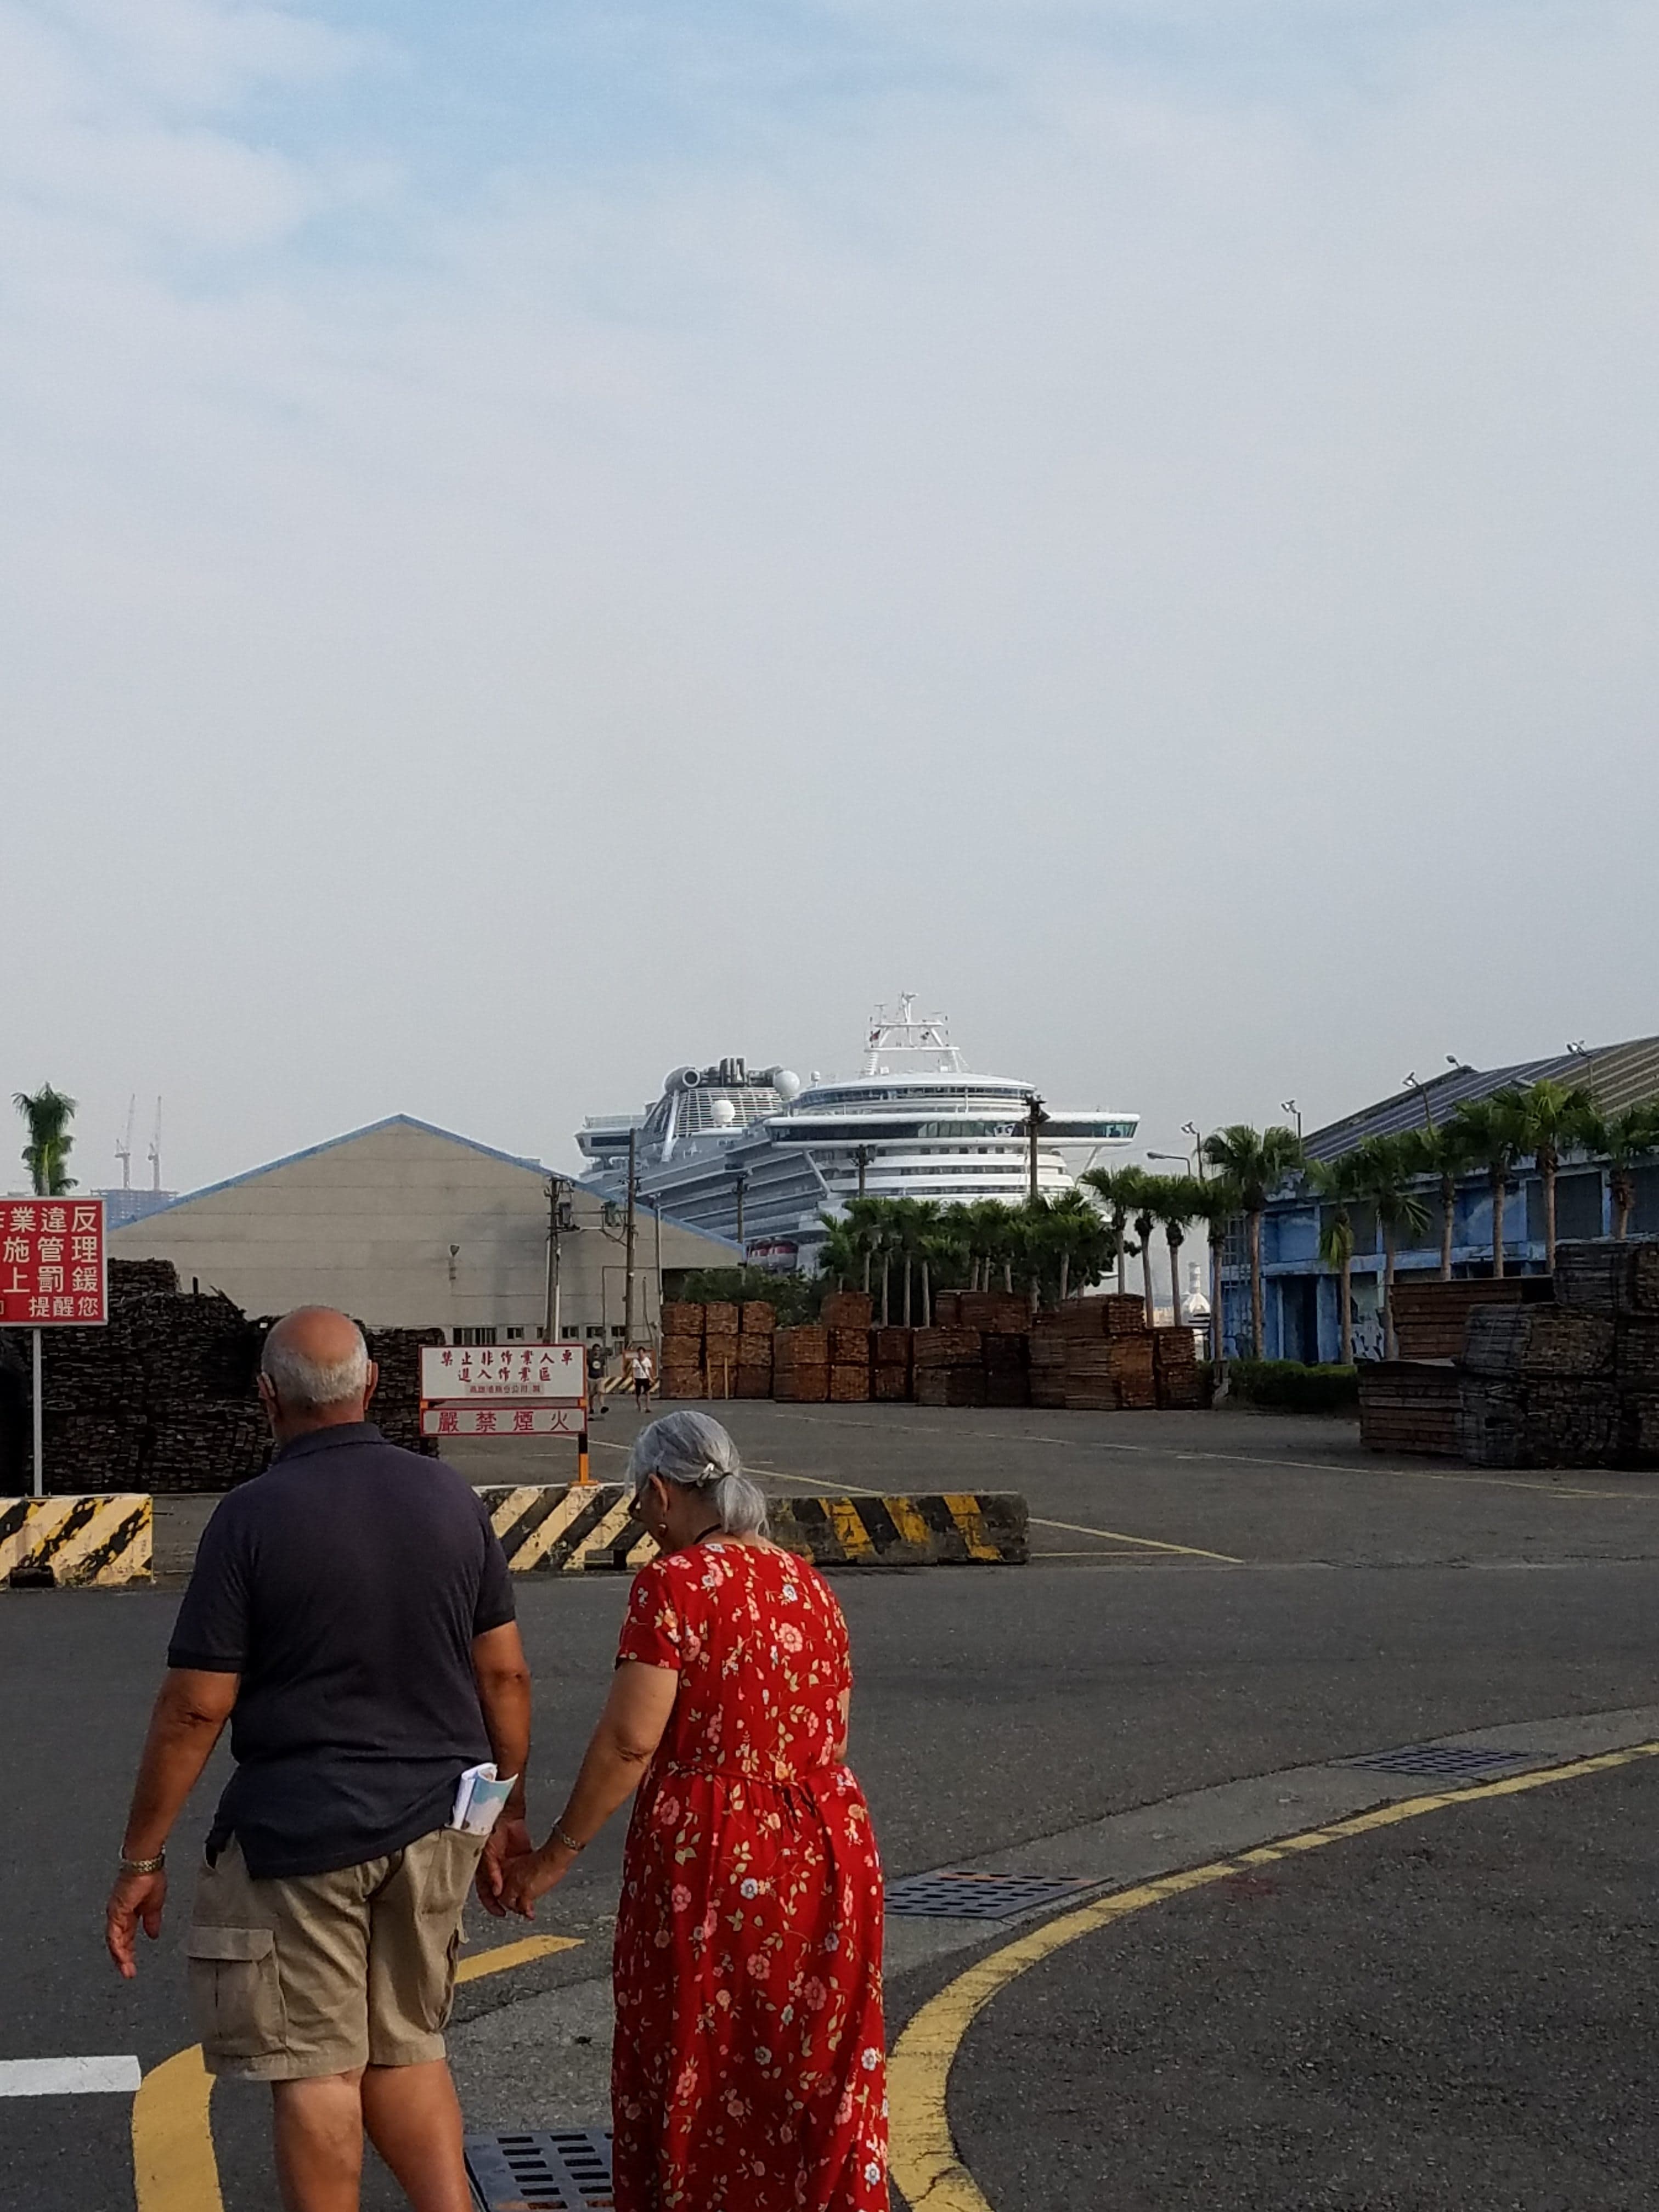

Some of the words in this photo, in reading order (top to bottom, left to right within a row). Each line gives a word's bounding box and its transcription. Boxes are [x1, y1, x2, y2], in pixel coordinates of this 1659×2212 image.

[3, 1236, 98, 1263] 施管理
[3, 1266, 98, 1293] 上罰鍰
[29, 1296, 99, 1317] 提醒您
[441, 1350, 573, 1366] 禁止非作業人車
[458, 1367, 552, 1382] 進入作業區
[437, 1410, 569, 1432] 嚴禁煙火
